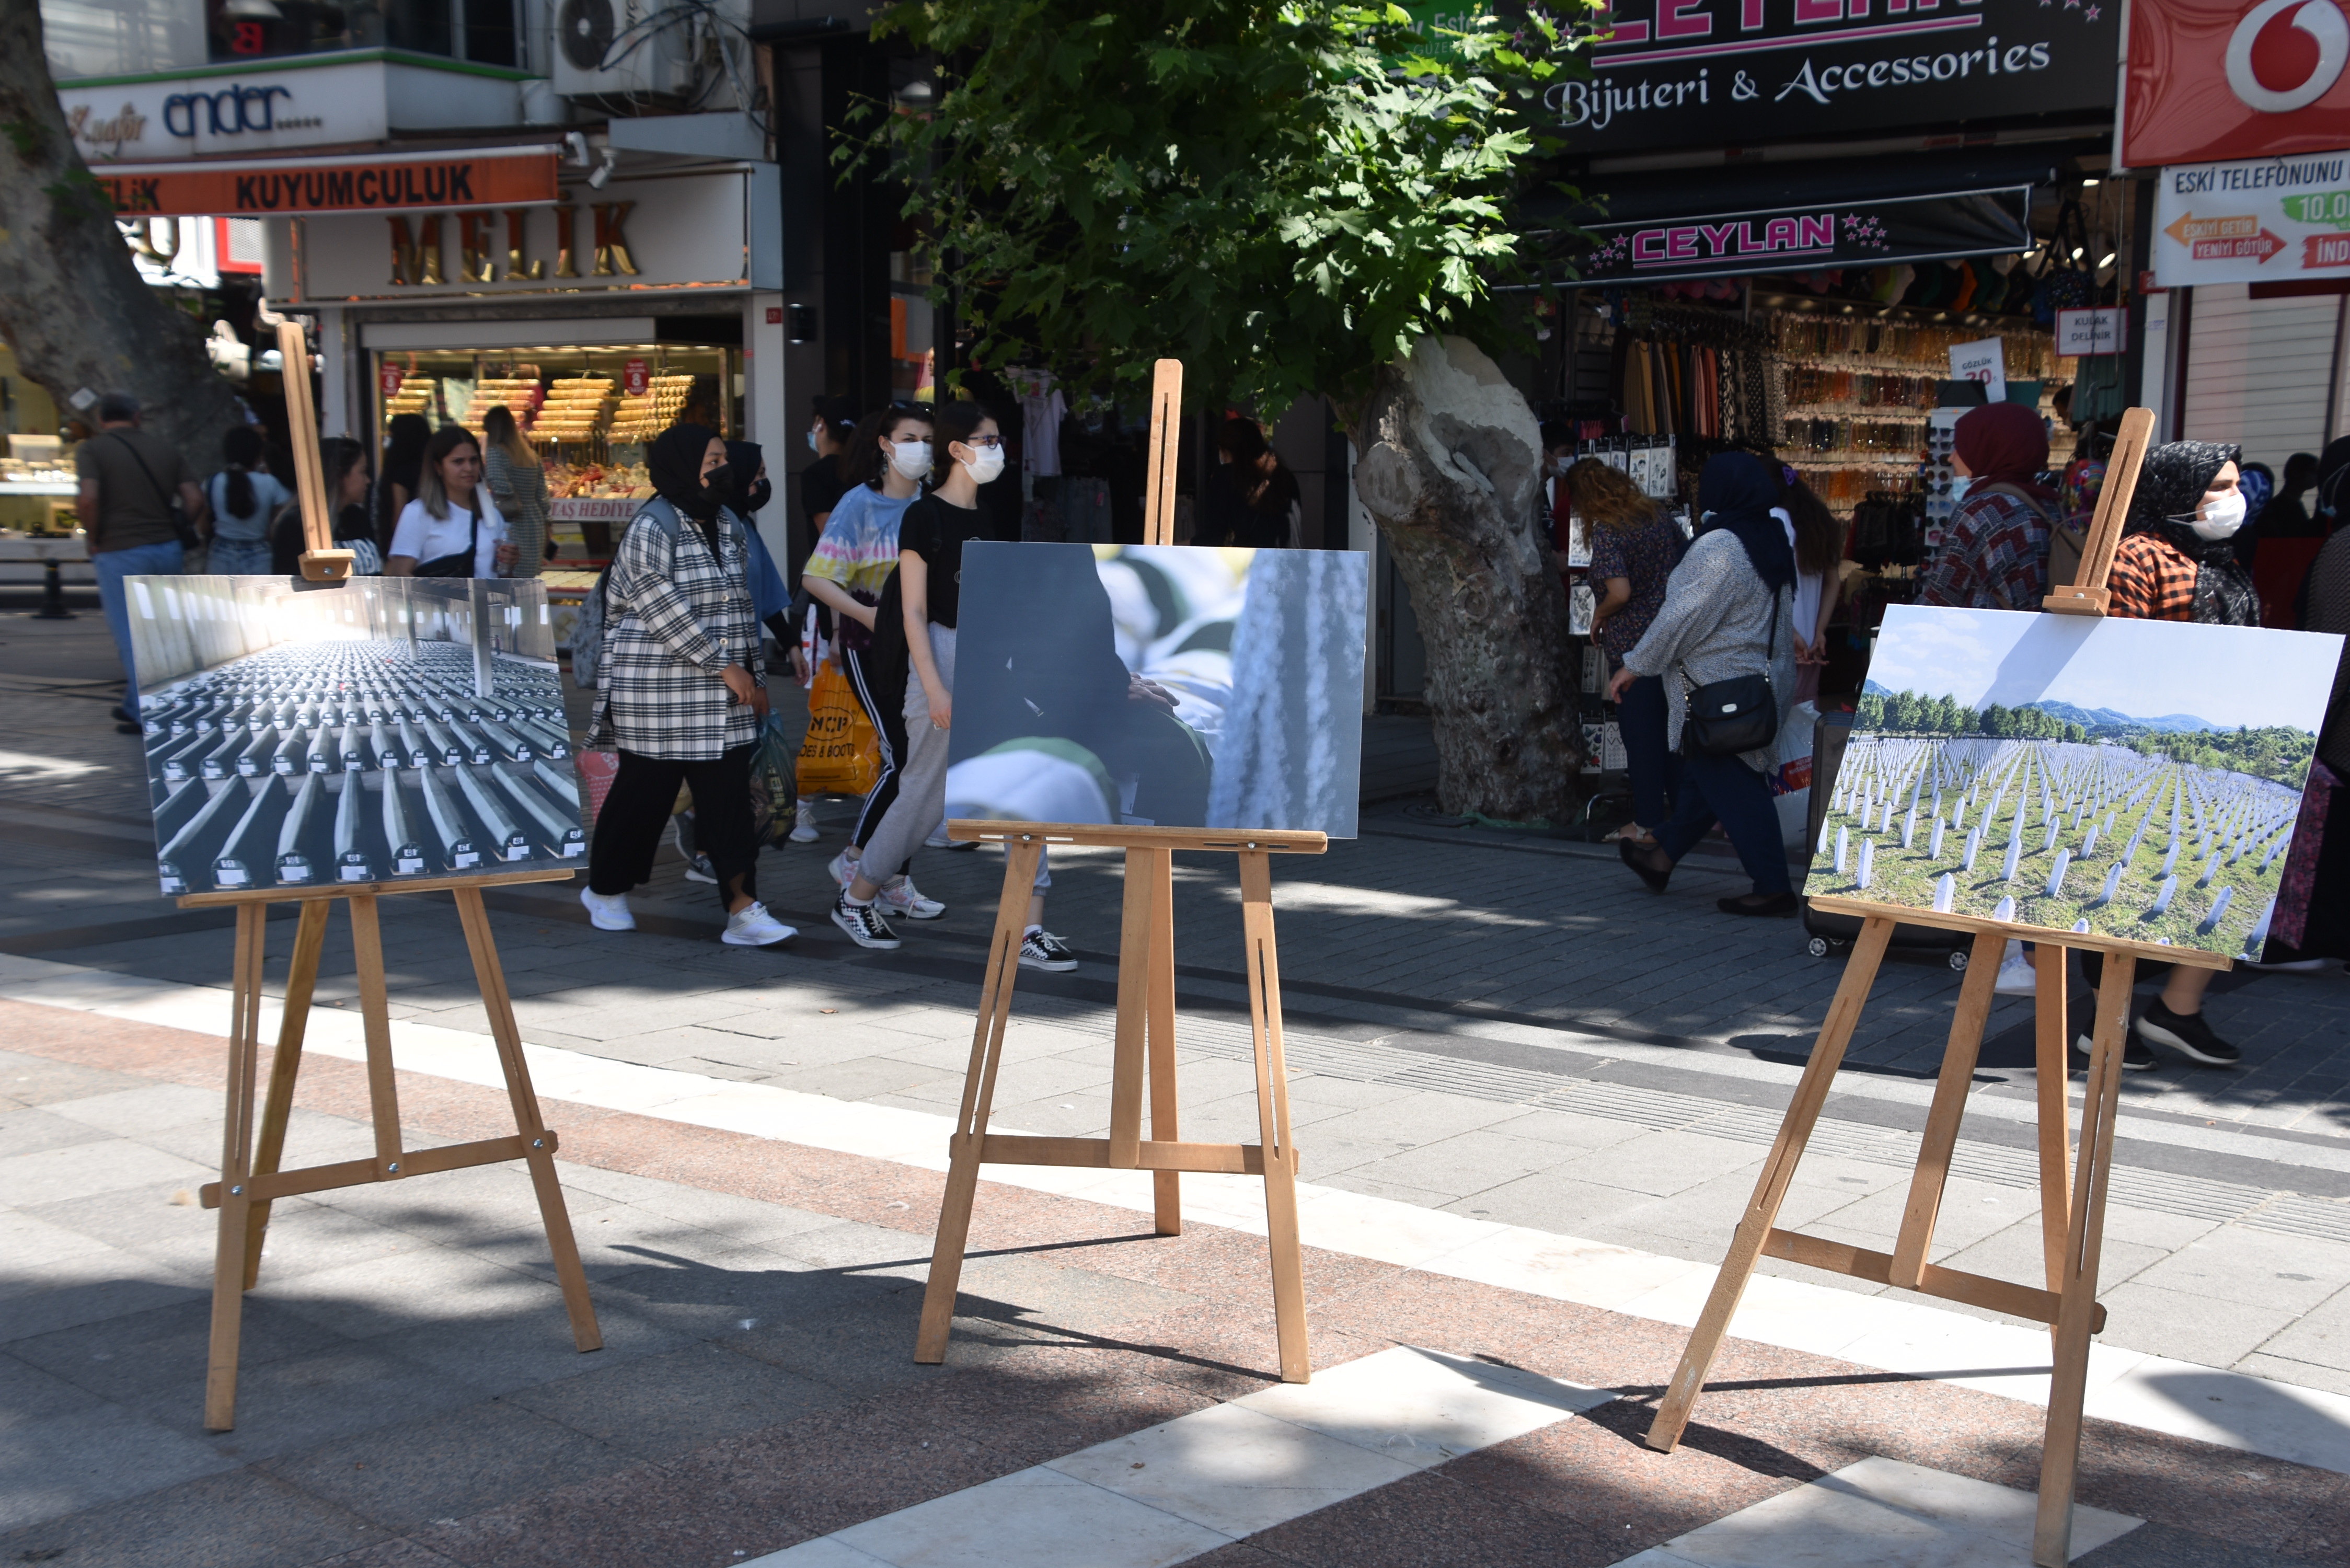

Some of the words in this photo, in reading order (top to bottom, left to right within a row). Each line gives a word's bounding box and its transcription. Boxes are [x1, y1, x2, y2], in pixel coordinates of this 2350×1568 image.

[1543, 68, 1710, 130] Bijuteri
[1731, 70, 1760, 101] &
[1775, 36, 2050, 104] Accessories
[2176, 166, 2216, 194] ESKİ
[2221, 159, 2343, 191] TELEFONUNU
[236, 164, 474, 209] KUYUMCULUK
[2299, 193, 2350, 221] 10.0
[2183, 218, 2218, 236] ESKİYİ
[2221, 217, 2253, 235] GETİR
[1632, 214, 1834, 261] CEYLAN
[2197, 239, 2233, 258] YENİYİ
[2236, 238, 2273, 255] GÖTÜR
[2075, 316, 2108, 326] KULAK
[1962, 358, 1992, 369] GÖZLÜK
[631, 372, 642, 386] 8
[579, 500, 636, 517] HEDİYE
[811, 717, 847, 732] MCP
[827, 743, 855, 757] BOOTS
